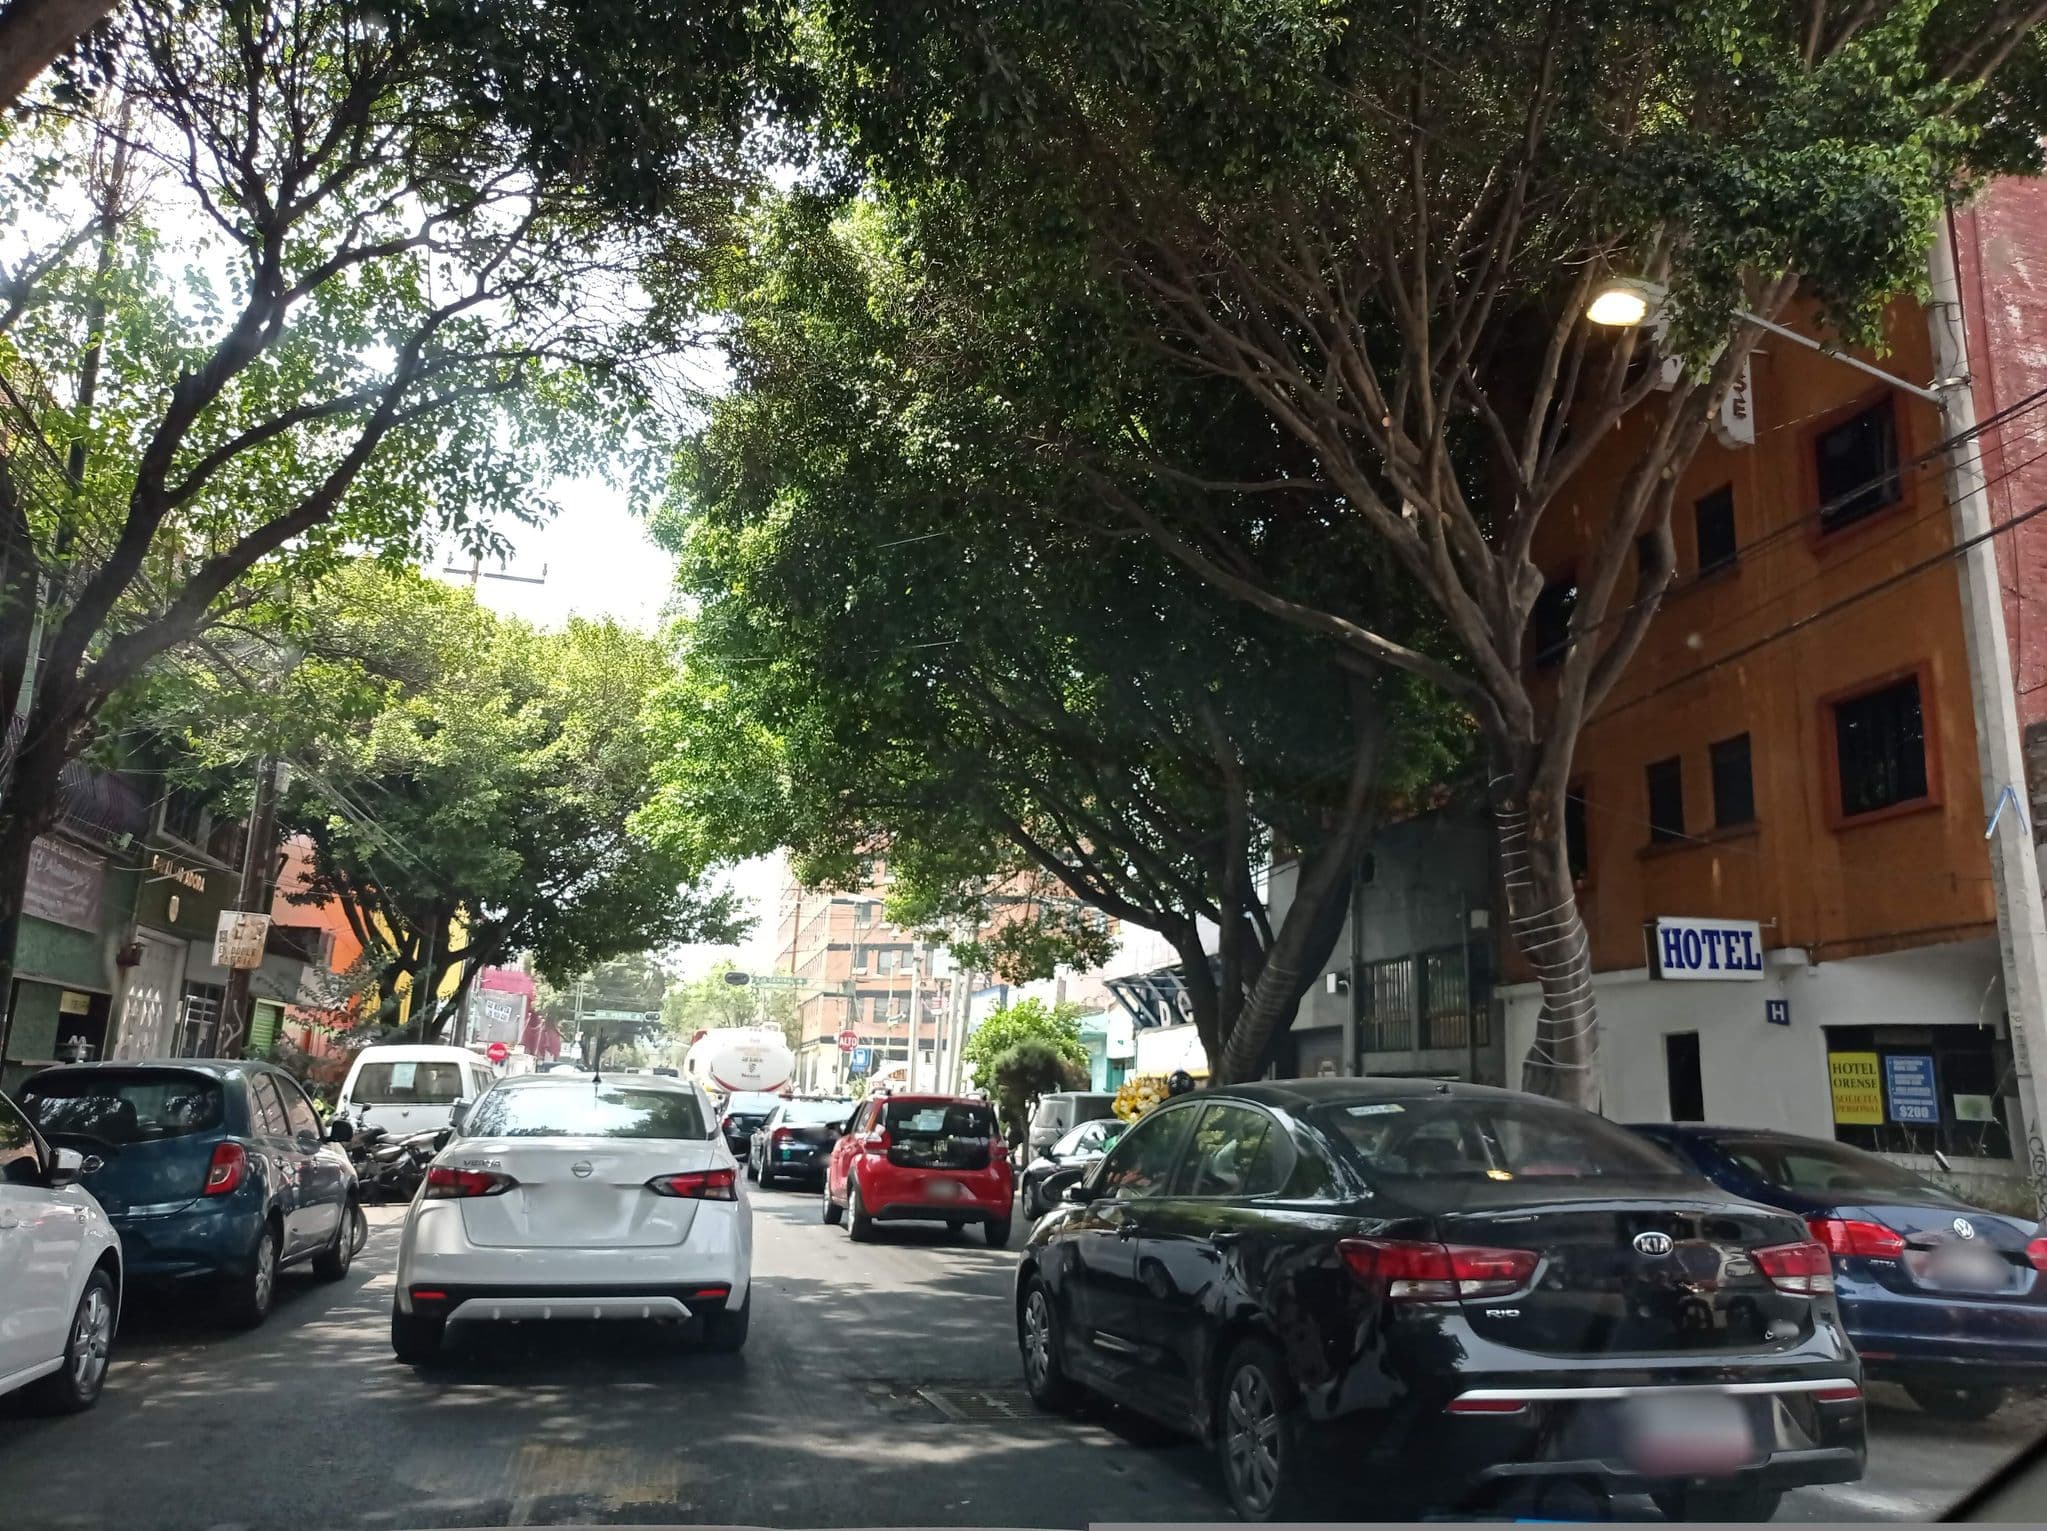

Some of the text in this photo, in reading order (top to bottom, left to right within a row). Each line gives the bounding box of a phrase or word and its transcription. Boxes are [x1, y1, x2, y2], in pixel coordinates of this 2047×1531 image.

[1661, 928, 1762, 971] HOTEL
[1771, 1003, 1785, 1021] H
[840, 1037, 857, 1047] ALTO
[1832, 1063, 1877, 1075] HOTEL
[1833, 1078, 1878, 1089] ORENSE
[1835, 1094, 1879, 1104] SOLICITA
[1836, 1103, 1879, 1114] PERSONAL
[1640, 1237, 1669, 1252] KIA
[1486, 1309, 1520, 1318] RIO
